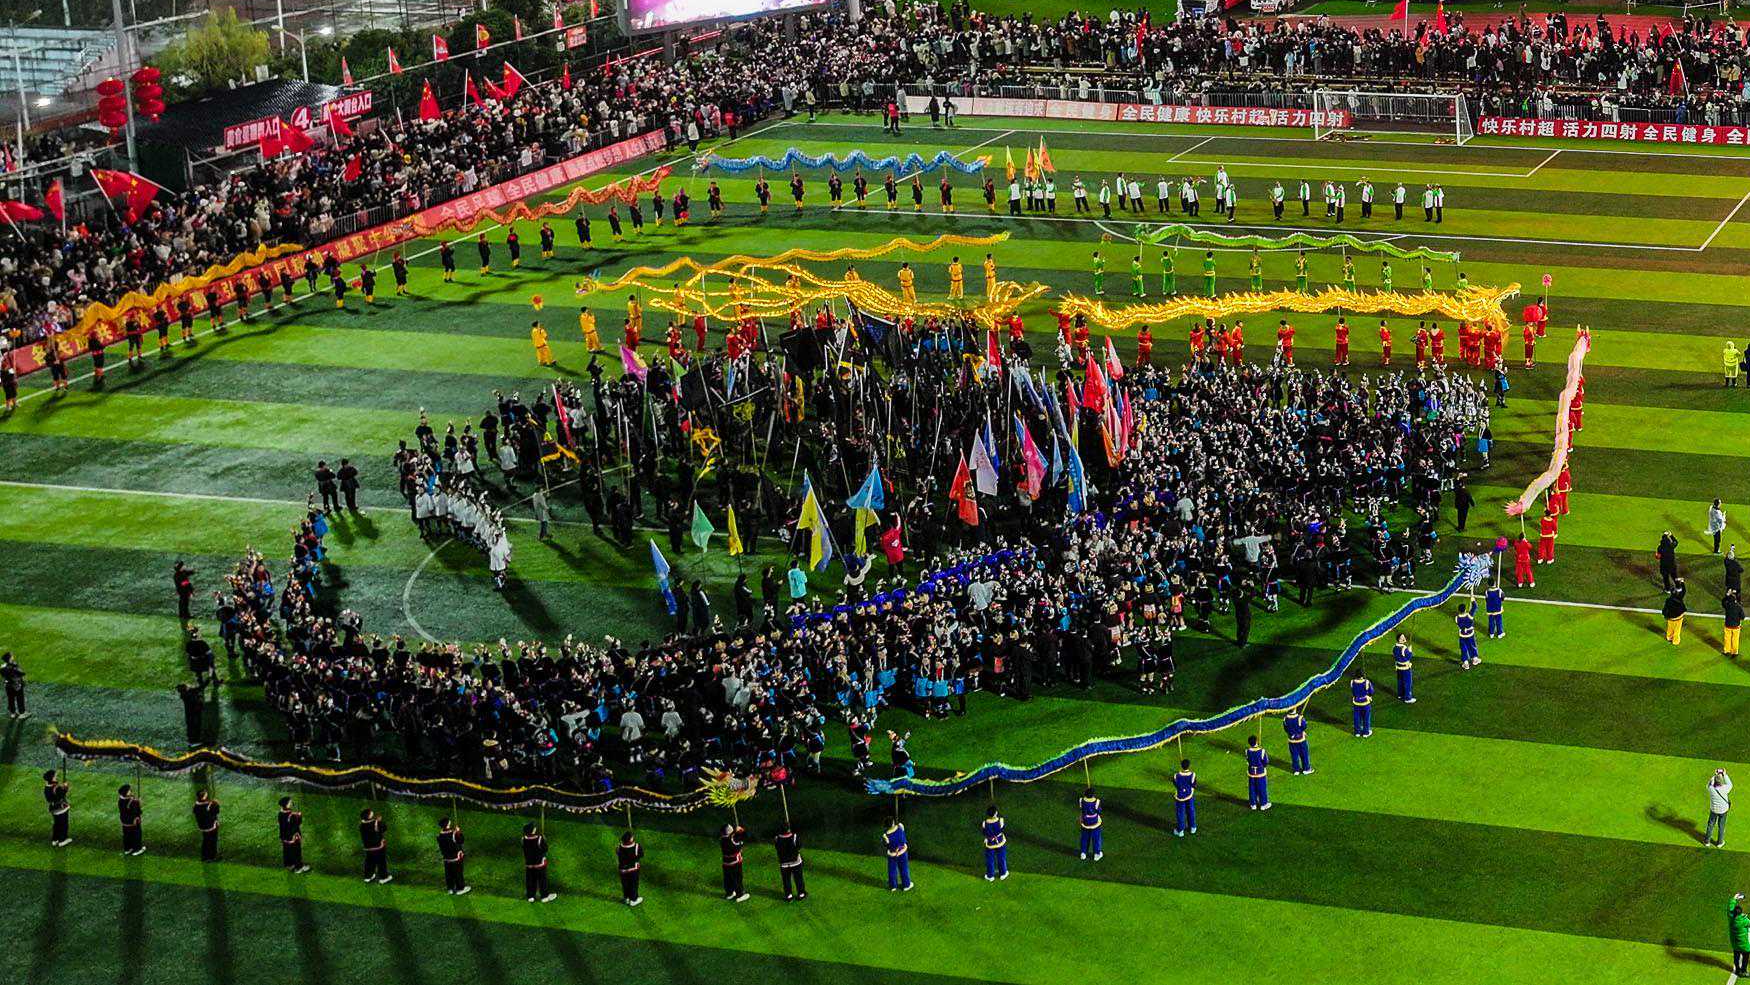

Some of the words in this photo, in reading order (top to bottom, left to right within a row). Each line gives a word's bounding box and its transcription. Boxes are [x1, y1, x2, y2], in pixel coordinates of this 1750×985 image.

[294, 107, 309, 129] 4
[1122, 106, 1190, 123] 全民健康
[1482, 118, 1555, 137] 快乐村超
[1562, 121, 1638, 140] 活力四射
[1643, 125, 1716, 144] 全民健身
